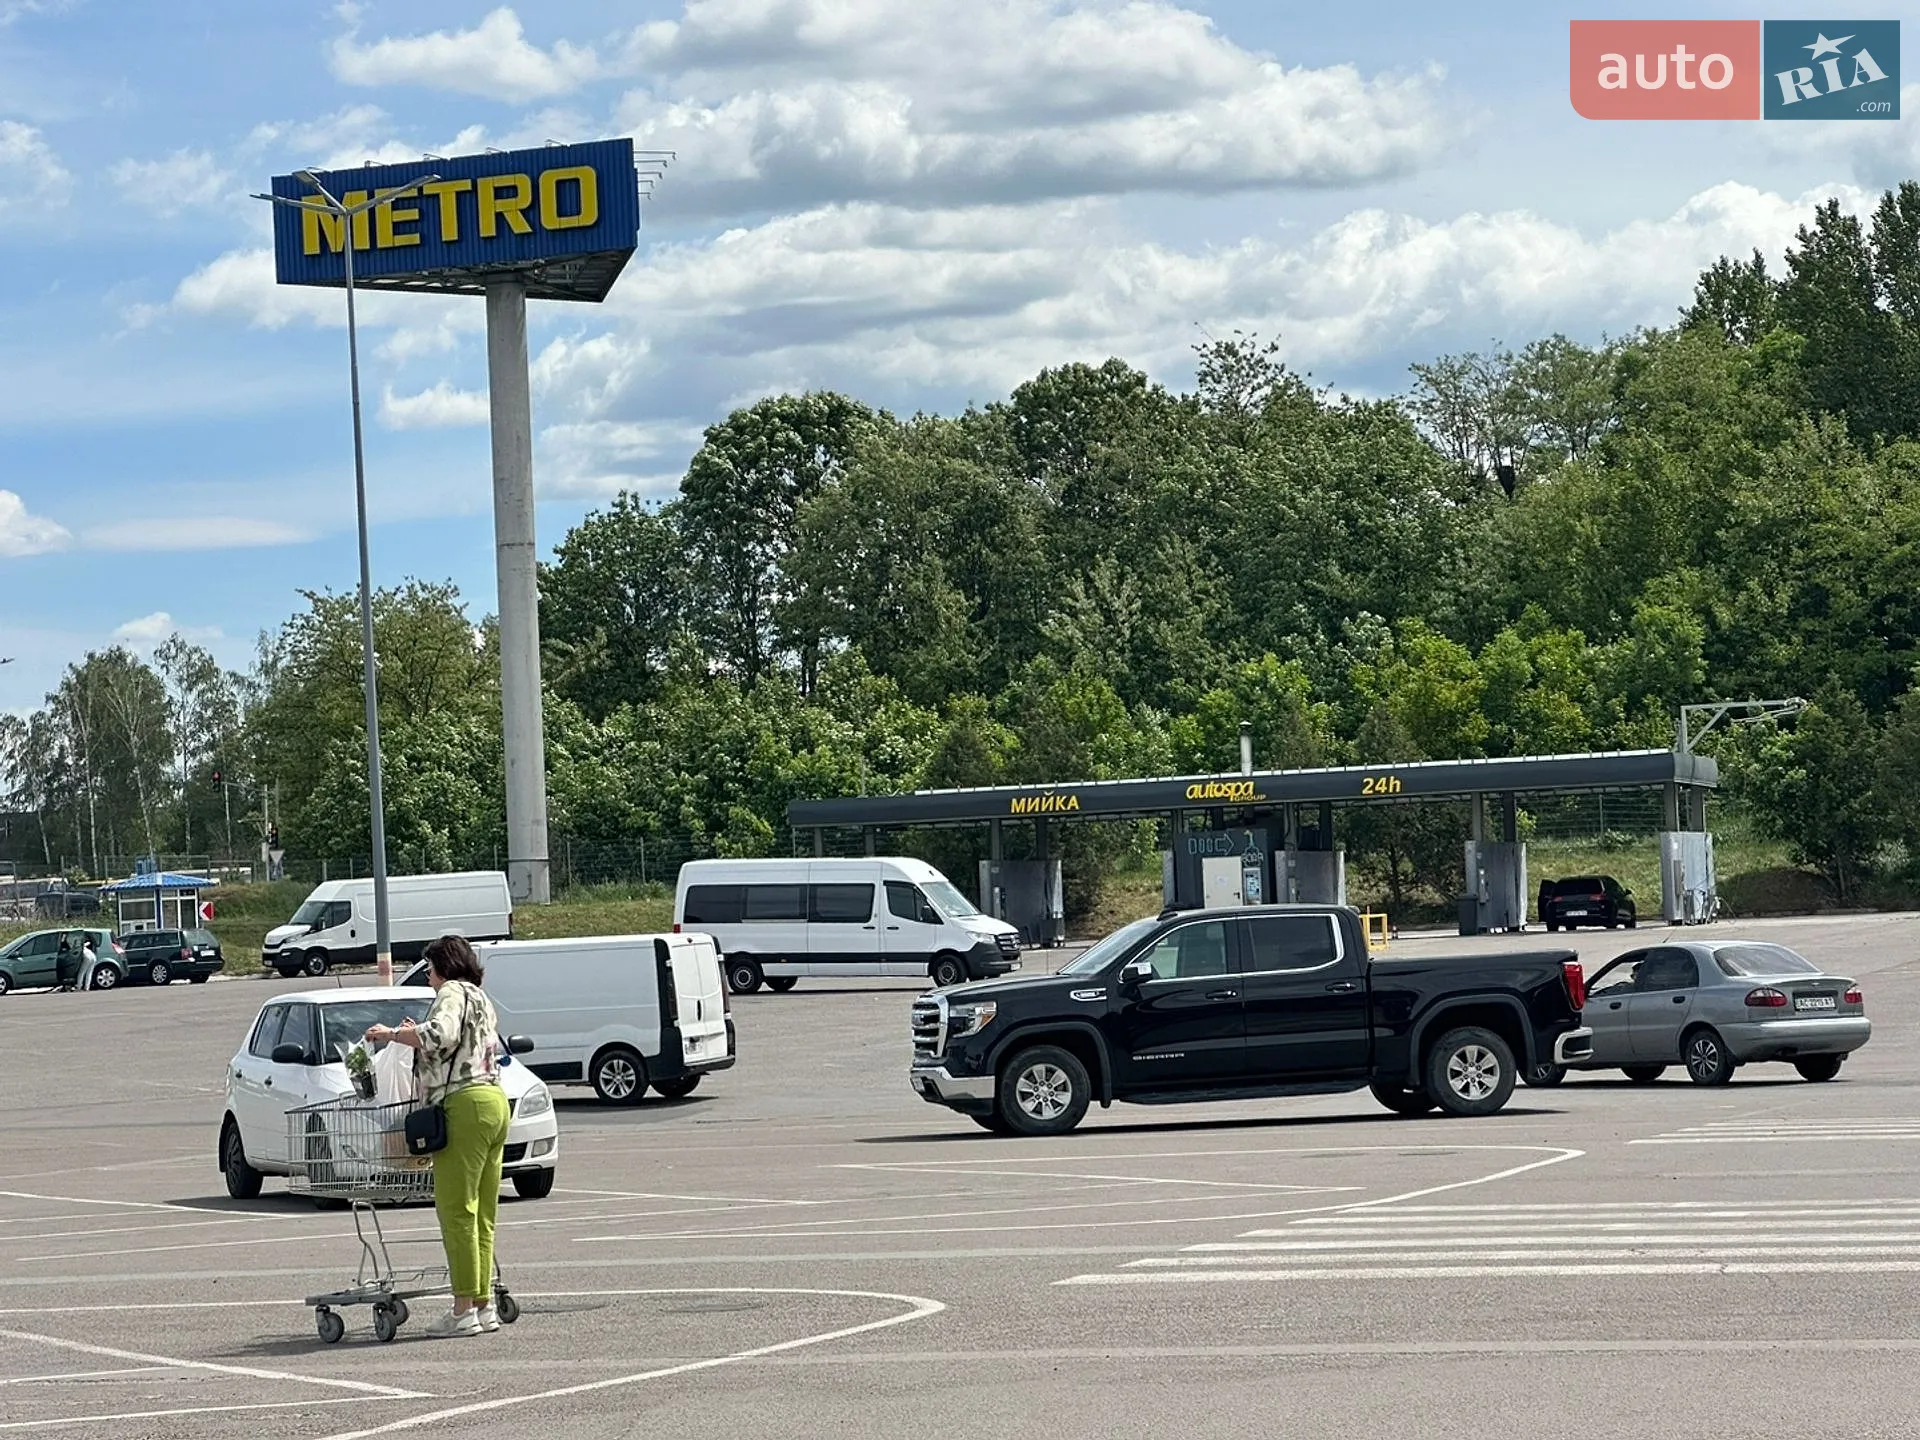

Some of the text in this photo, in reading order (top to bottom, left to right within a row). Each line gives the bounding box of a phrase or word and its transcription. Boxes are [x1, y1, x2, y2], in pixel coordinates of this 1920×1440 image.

[302, 165, 598, 255] METRO
[1186, 781, 1254, 801] autospa
[1362, 776, 1401, 795] 24h
[1011, 790, 1079, 813] МИЙКА
